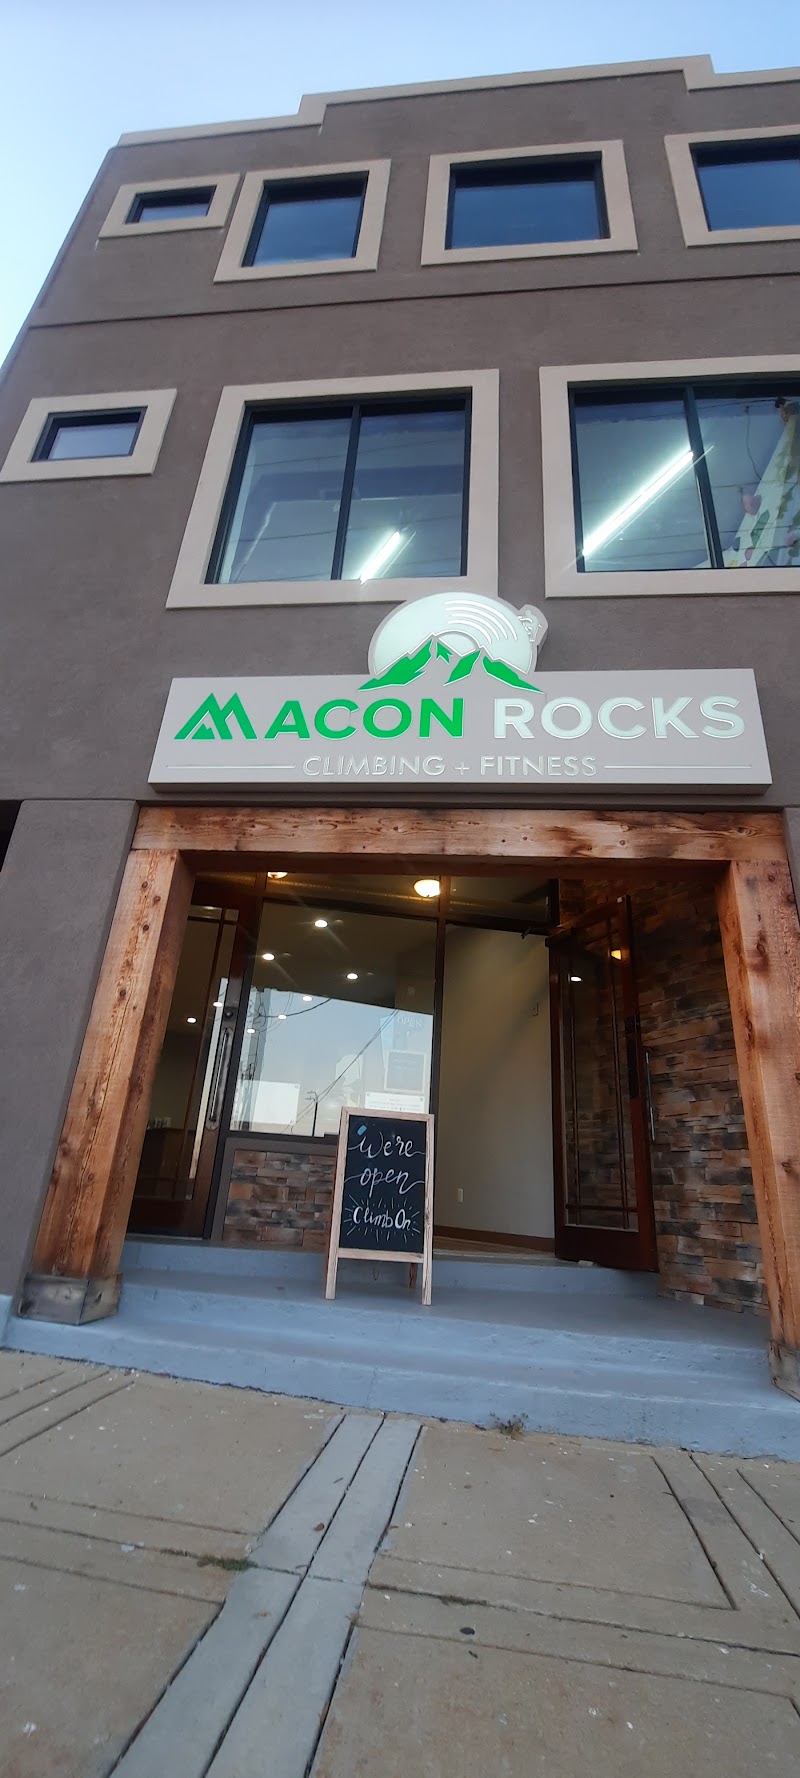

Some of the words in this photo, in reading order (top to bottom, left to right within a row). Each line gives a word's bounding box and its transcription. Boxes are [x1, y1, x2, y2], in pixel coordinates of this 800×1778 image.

[174, 692, 464, 741] MACON
[493, 696, 746, 740] ROCKS
[302, 754, 446, 777] CLIMBING
[454, 760, 468, 775] +
[479, 754, 597, 777] FITNESS
[353, 1167, 416, 1198] open
